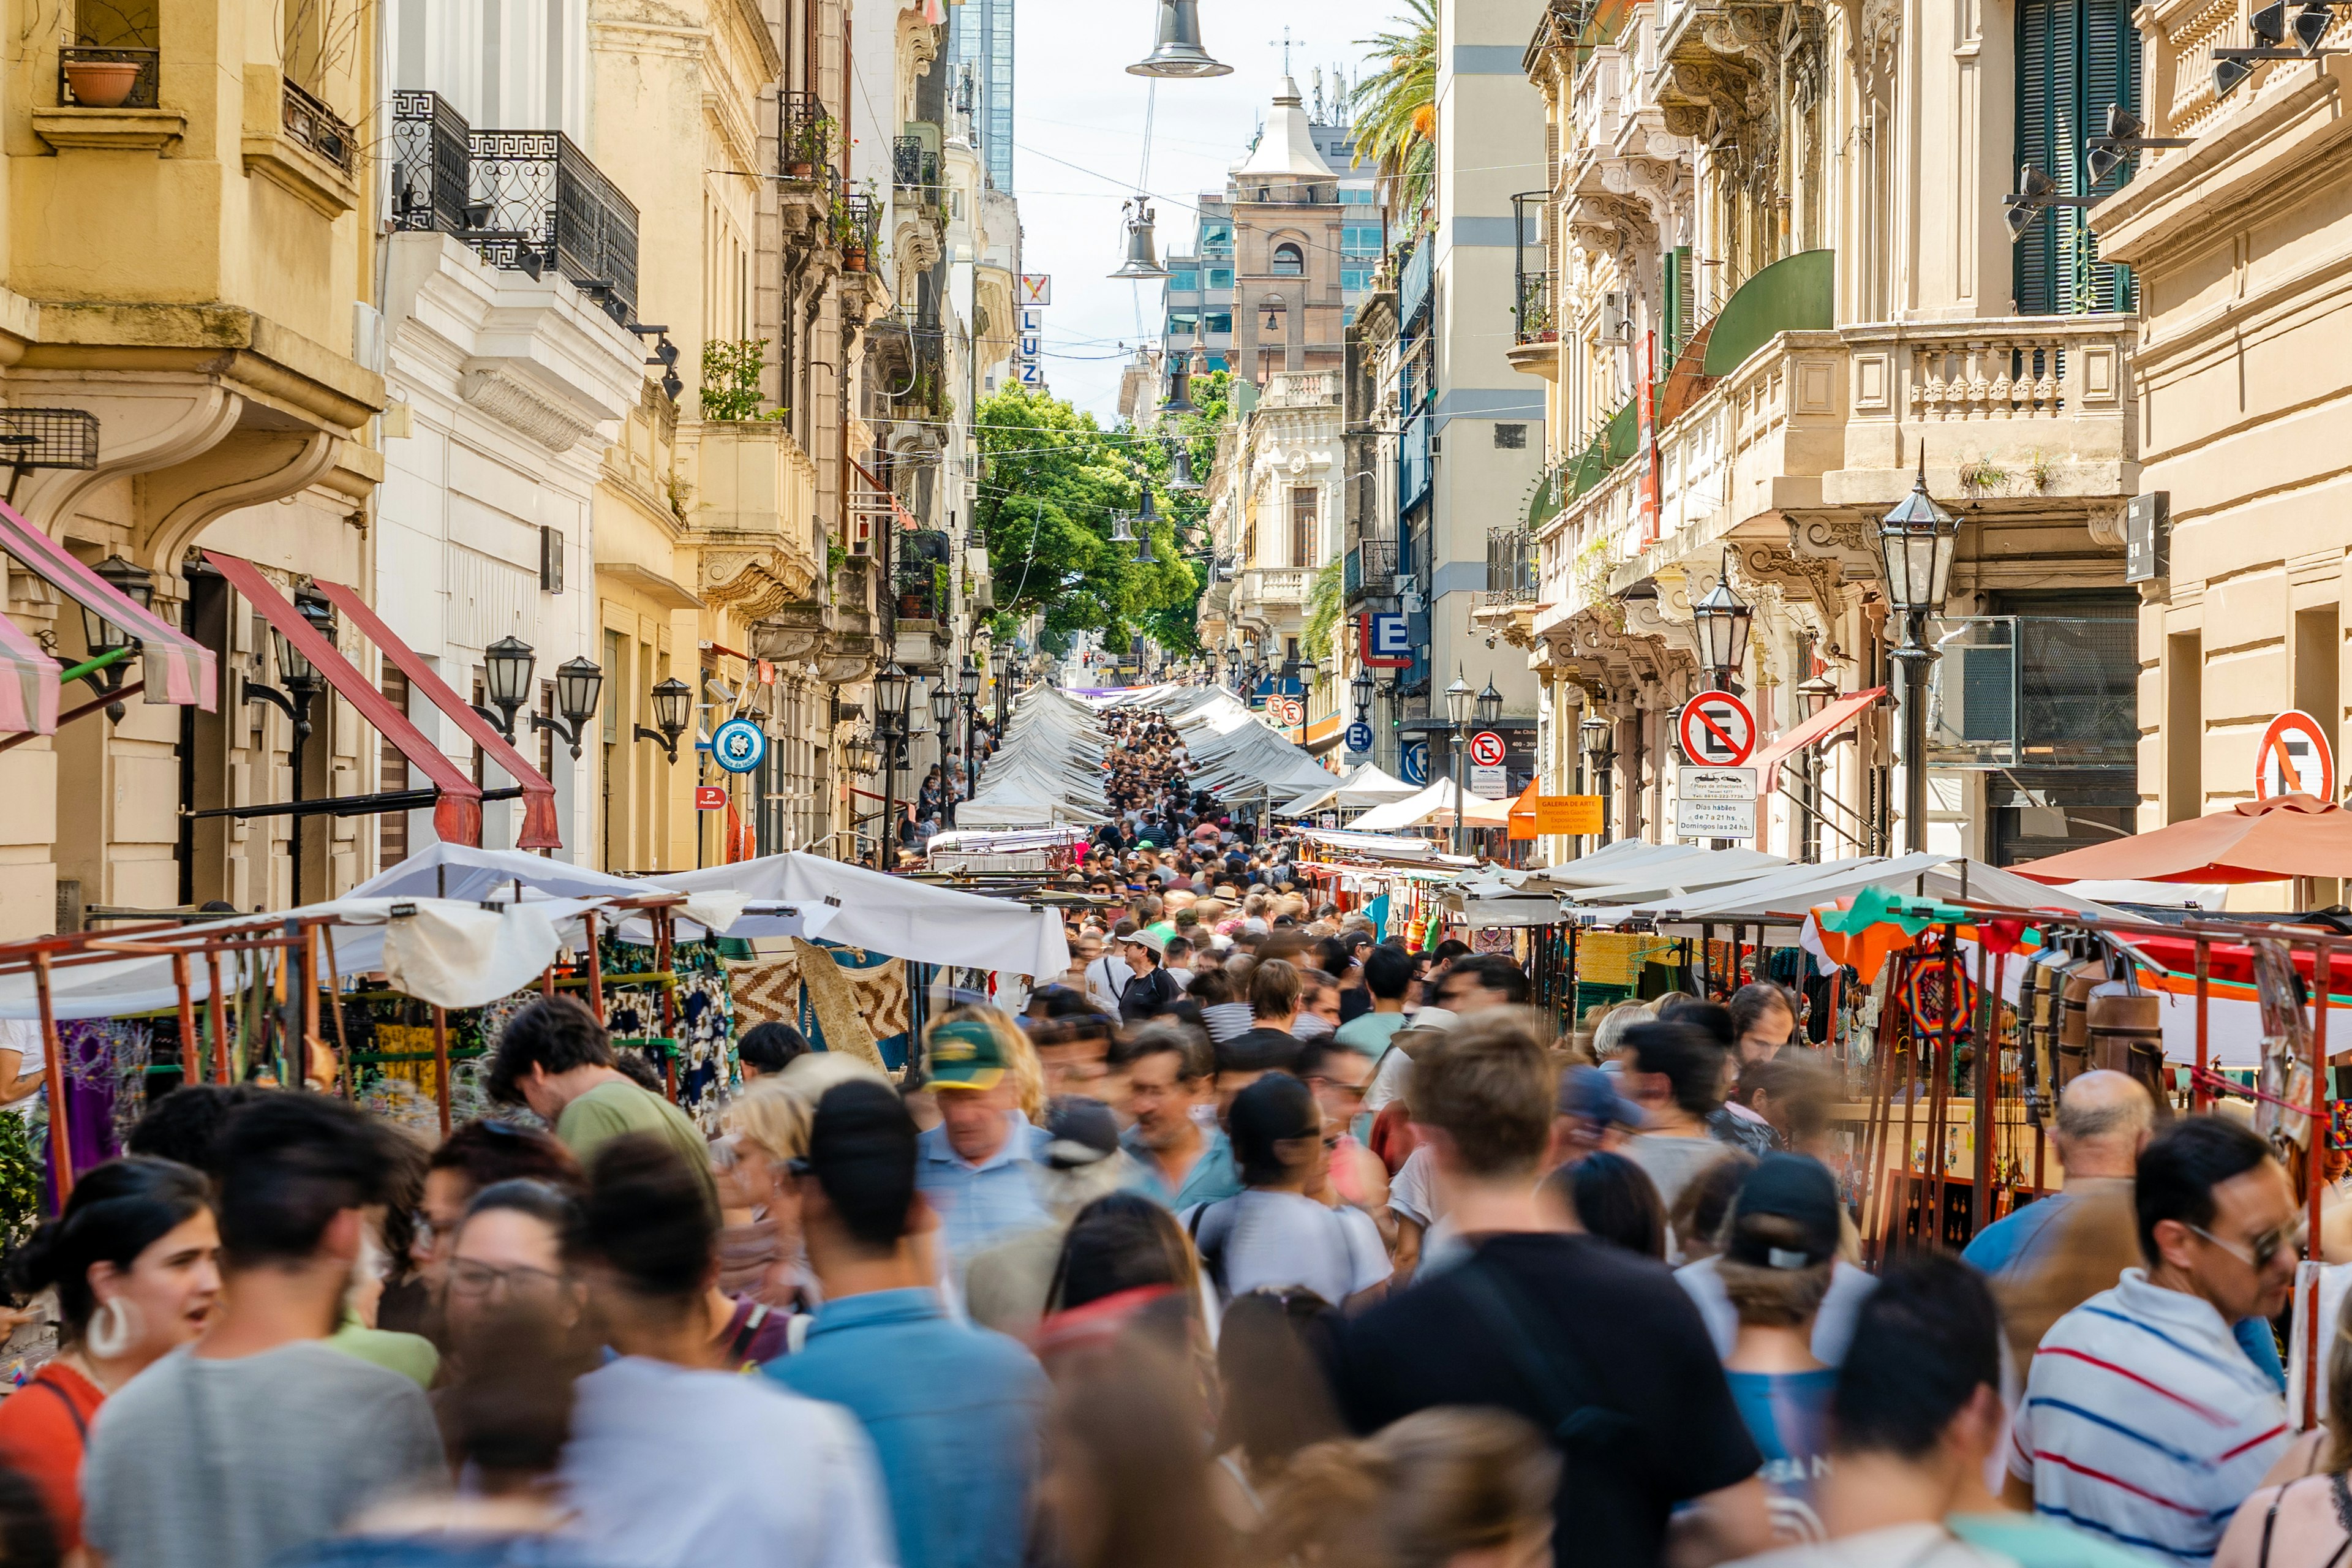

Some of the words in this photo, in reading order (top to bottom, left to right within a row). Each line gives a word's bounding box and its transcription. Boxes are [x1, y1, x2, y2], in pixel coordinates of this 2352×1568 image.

[1023, 312, 1036, 382] LUZ
[1379, 617, 1412, 650] E
[1287, 707, 1296, 719] E
[1350, 726, 1362, 745] E
[1703, 710, 1735, 754] E
[1481, 740, 1494, 759] E
[742, 756, 756, 767] leche
[1681, 822, 1716, 831] Domingos
